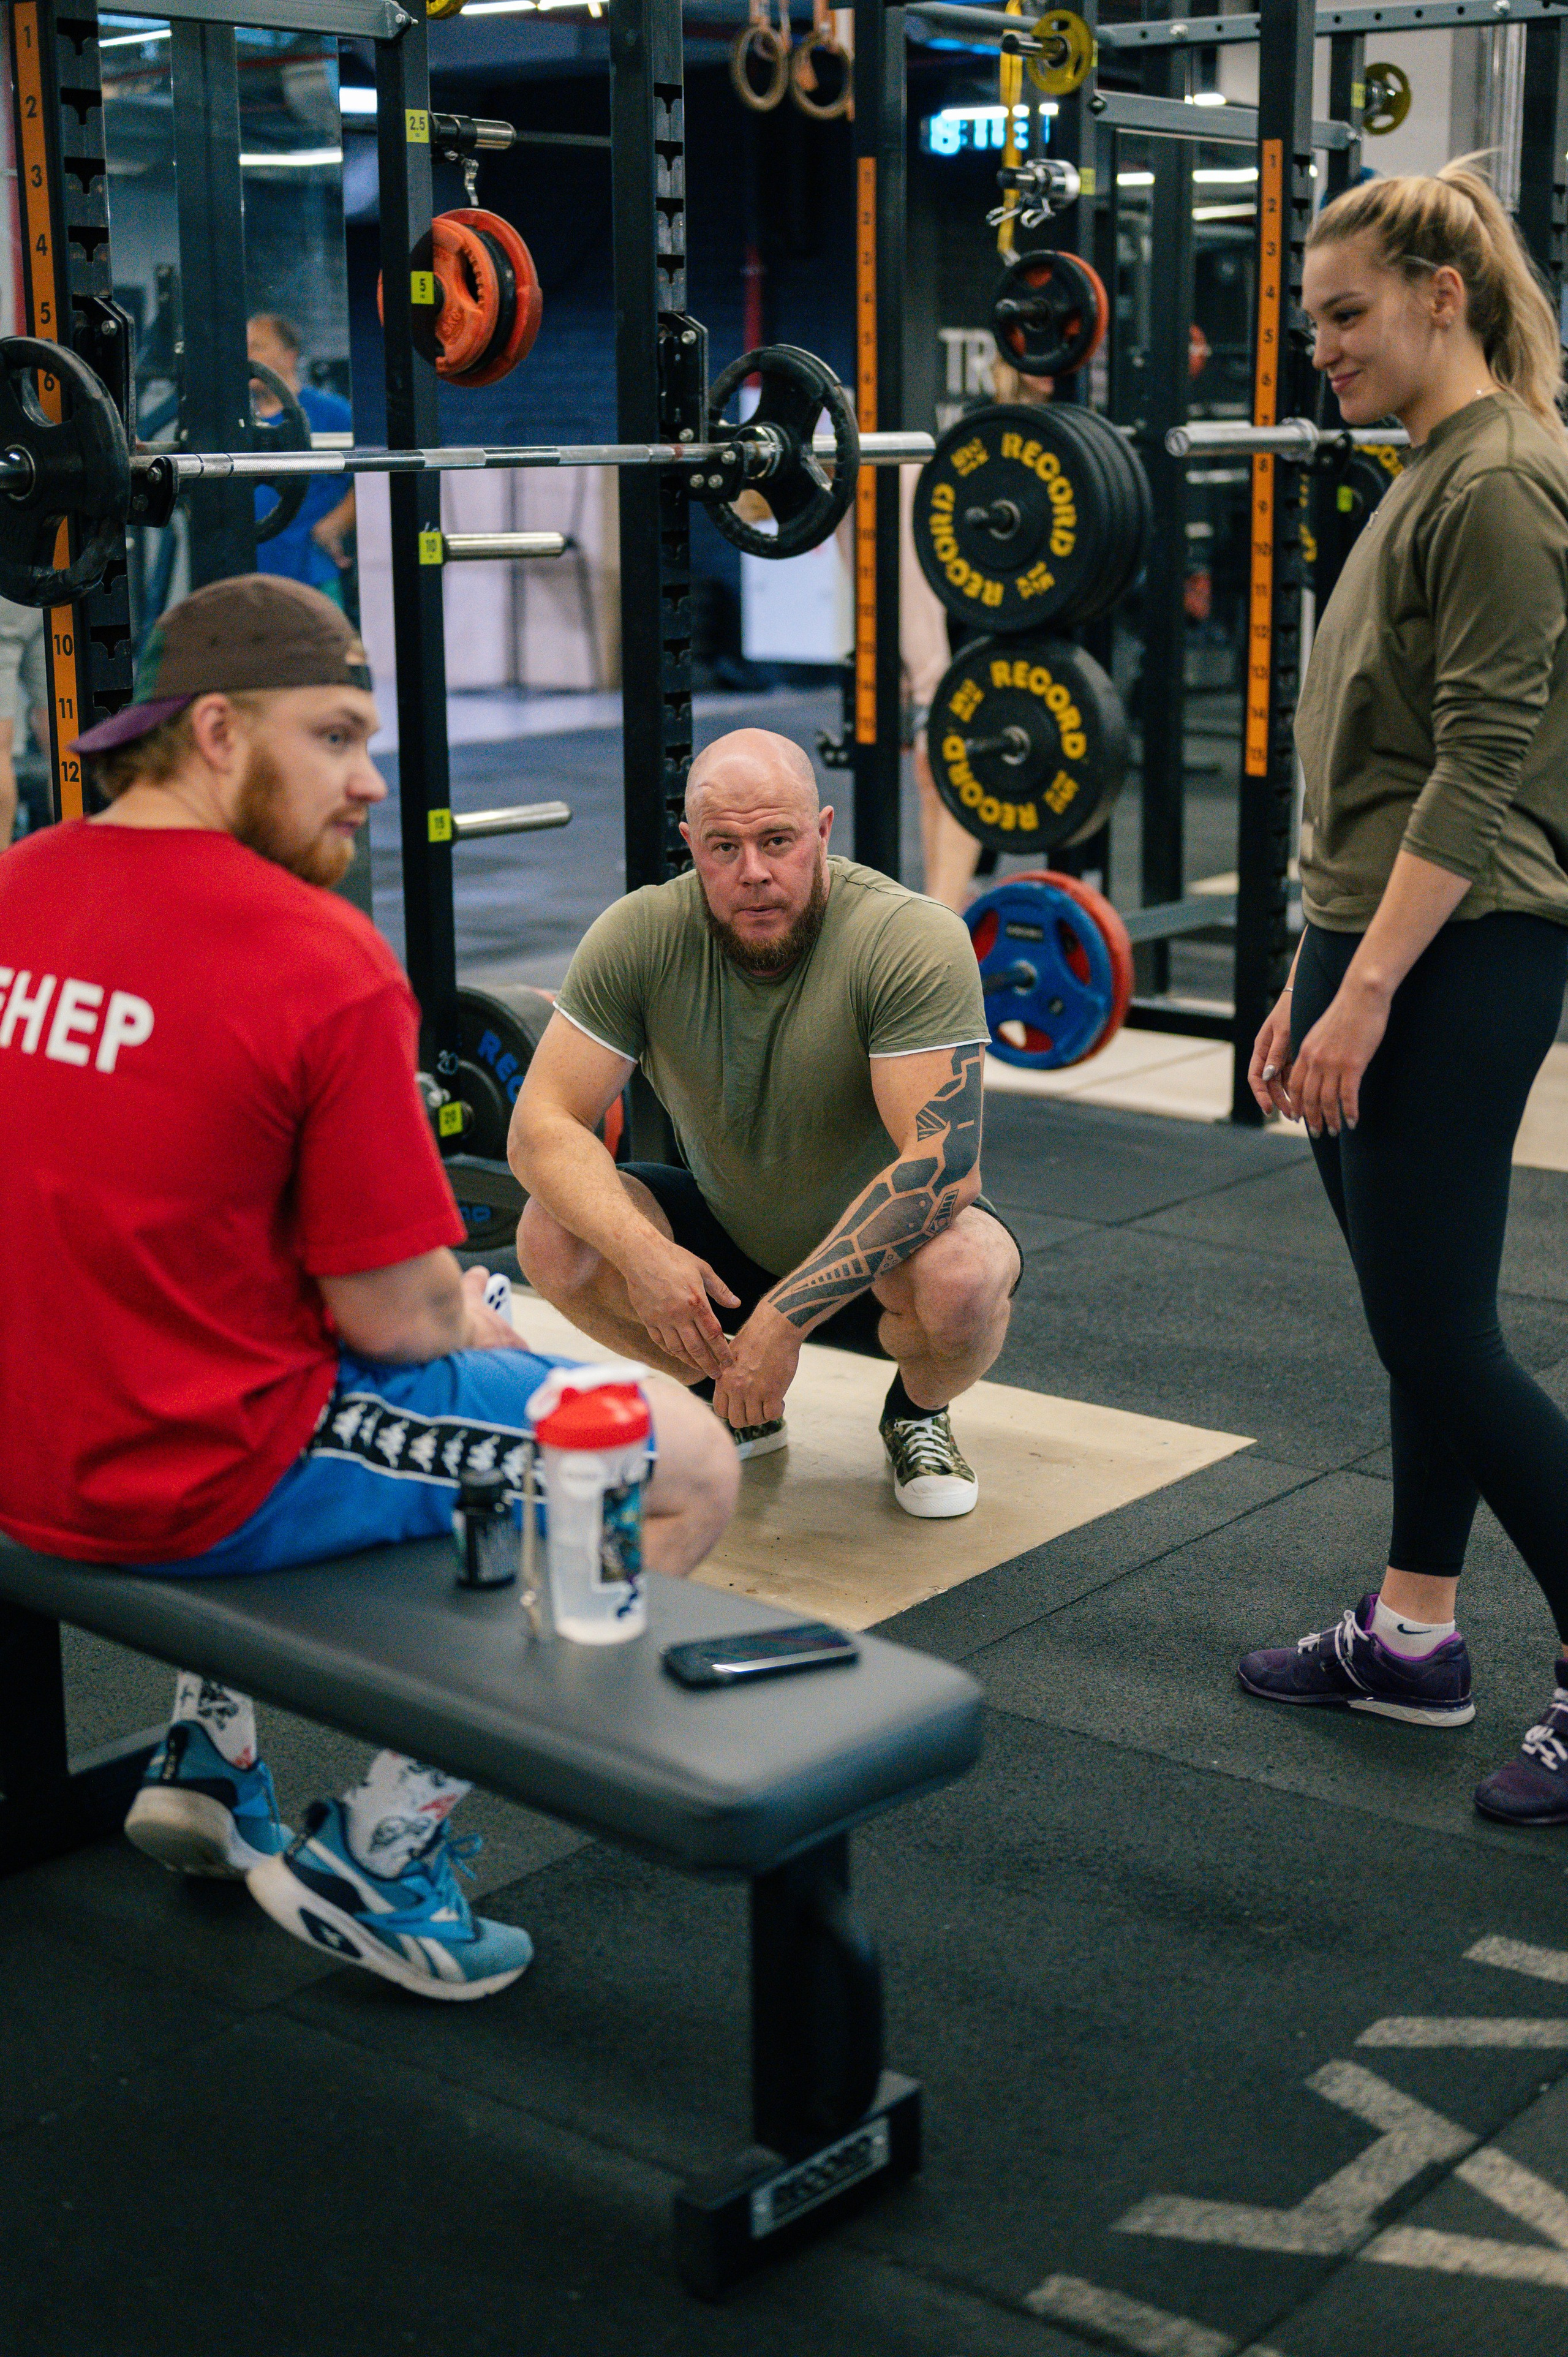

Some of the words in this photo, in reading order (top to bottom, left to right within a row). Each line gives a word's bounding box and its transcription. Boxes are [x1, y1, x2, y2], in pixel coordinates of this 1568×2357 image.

[23, 26, 31, 48] 1
[25, 95, 37, 118] 2
[409, 116, 425, 130] 2.5
[31, 164, 42, 187] 3
[36, 234, 48, 255] 4
[420, 277, 426, 292] 5
[40, 302, 50, 324] 5
[43, 369, 55, 391] 6
[1000, 432, 1077, 557] RECORD
[929, 483, 1004, 607] RECORD
[53, 634, 73, 656] 10
[59, 698, 73, 719] 11
[990, 659, 1087, 760] RECORD
[61, 761, 80, 783] 12
[941, 734, 1039, 831] RECORD
[0, 966, 156, 1074] НЕР
